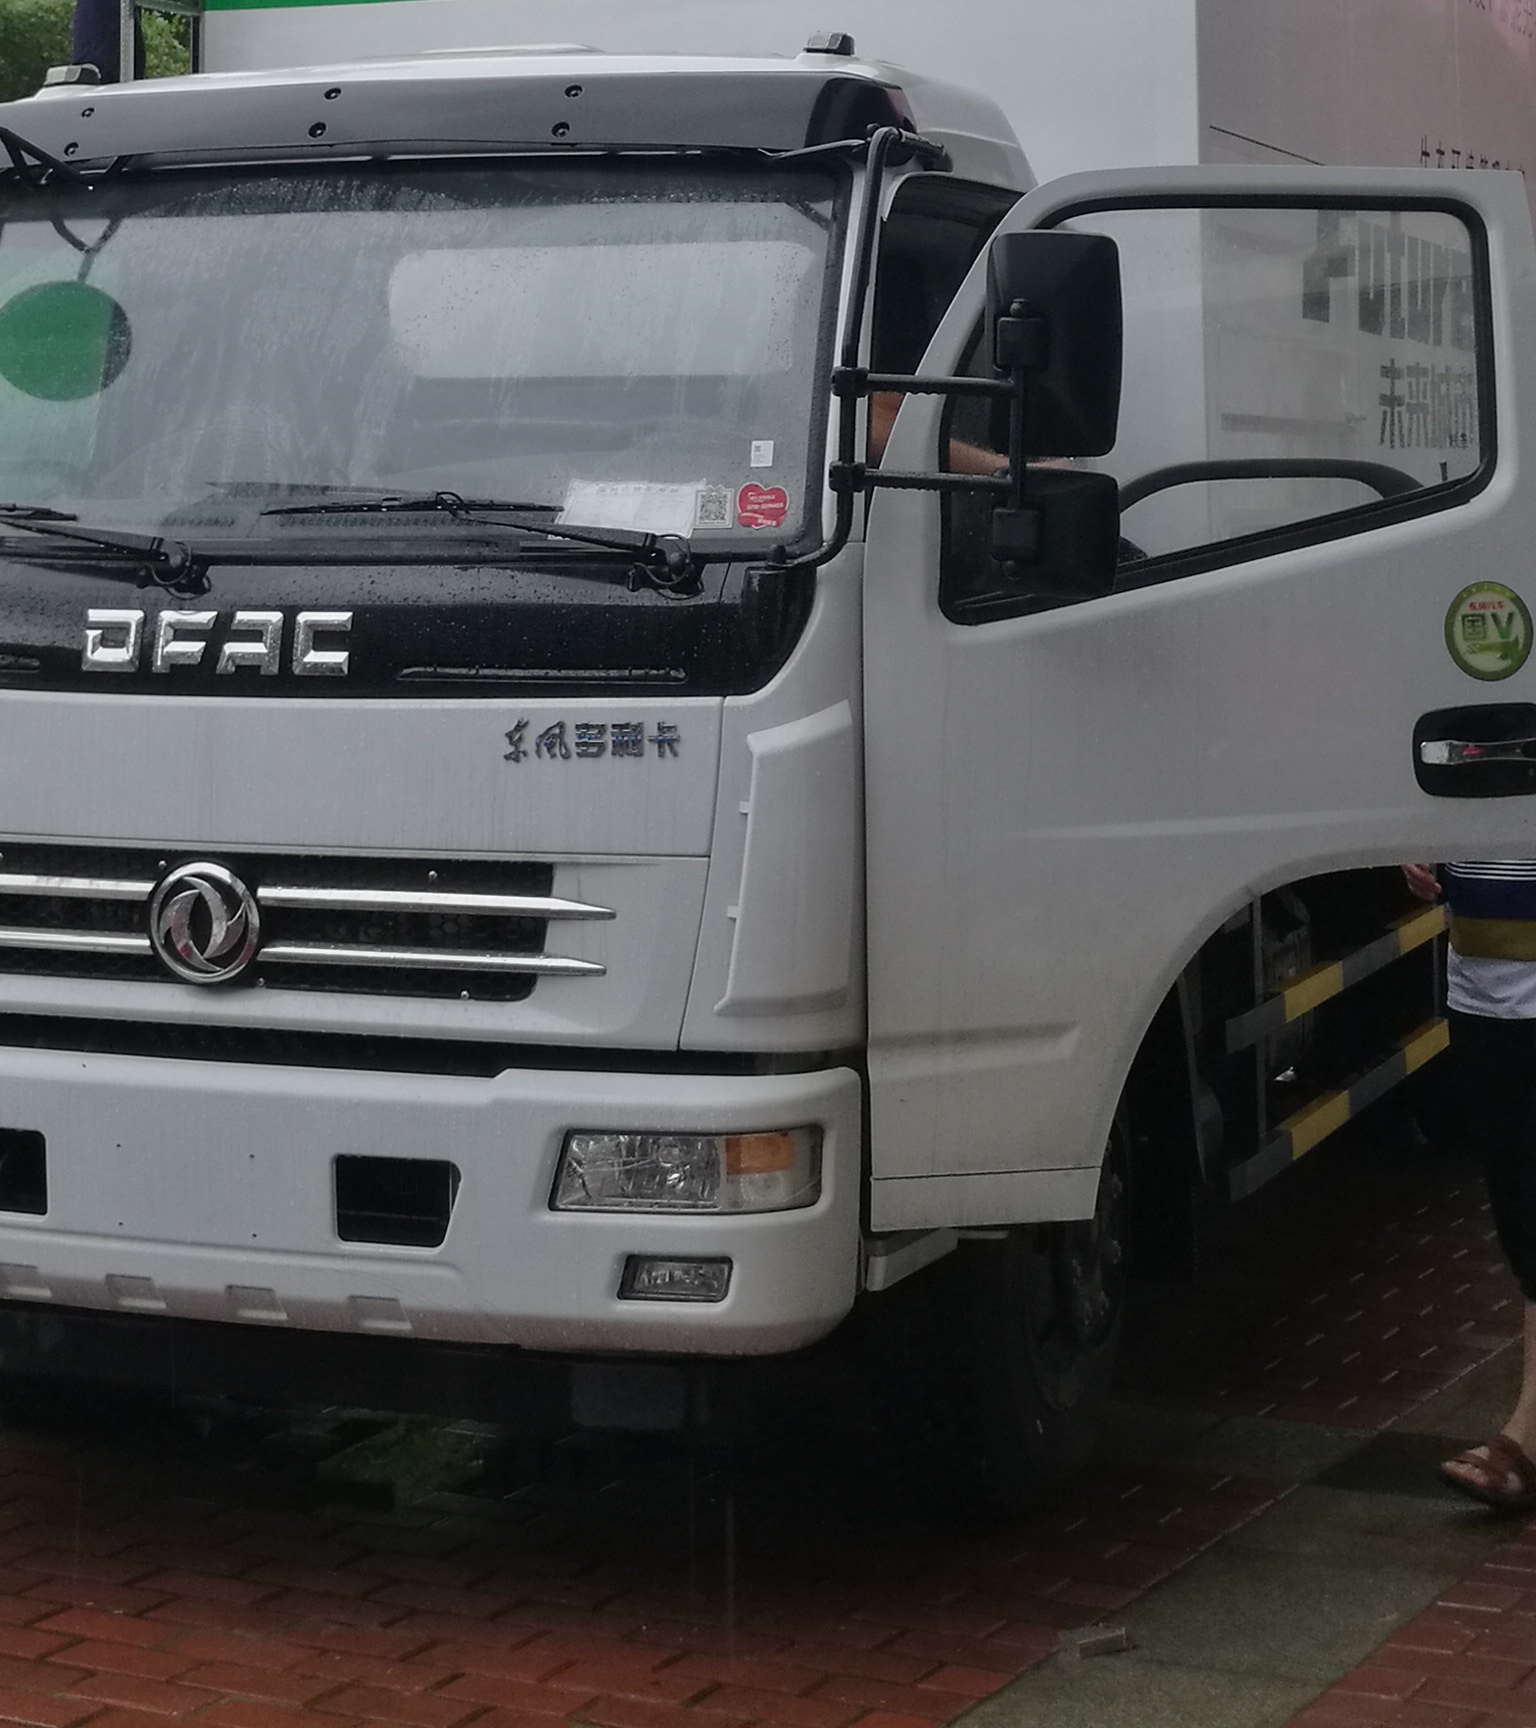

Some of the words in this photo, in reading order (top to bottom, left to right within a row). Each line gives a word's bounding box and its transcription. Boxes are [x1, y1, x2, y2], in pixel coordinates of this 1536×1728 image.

[81, 608, 354, 677] DFAC
[502, 717, 681, 763] 东风多利卡
